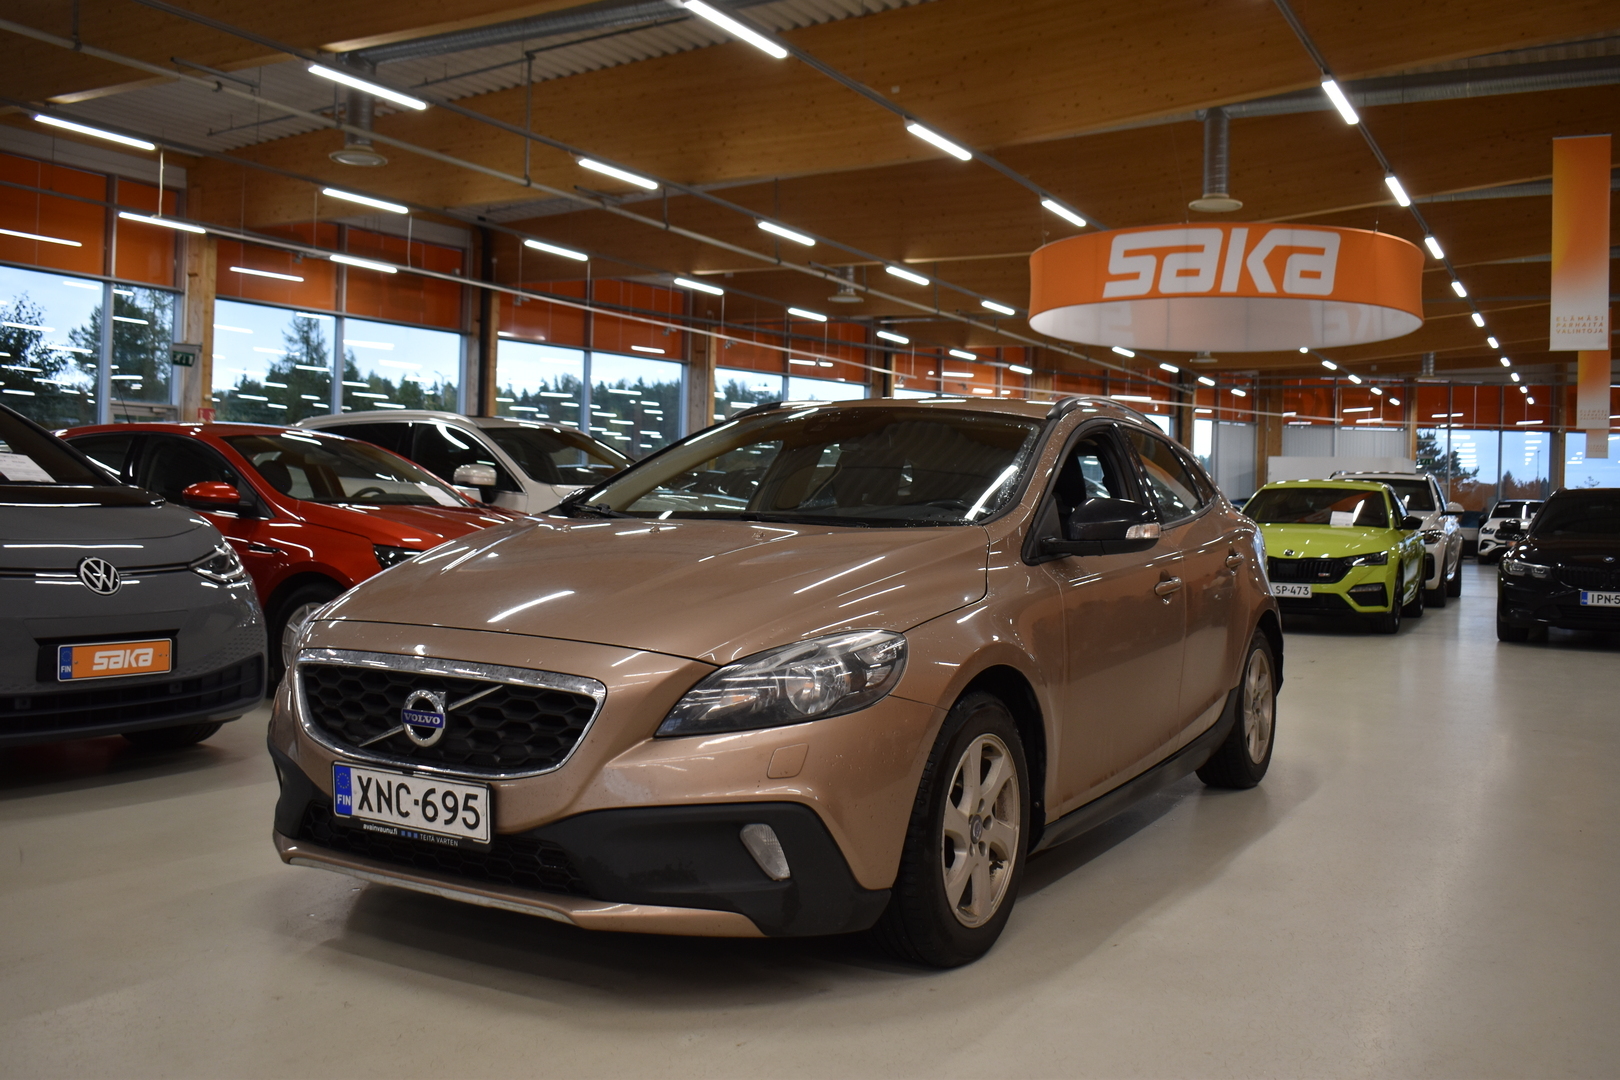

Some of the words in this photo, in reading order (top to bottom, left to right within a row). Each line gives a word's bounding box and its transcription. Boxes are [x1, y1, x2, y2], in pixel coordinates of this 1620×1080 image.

[1273, 585, 1309, 596] SP-473
[60, 665, 72, 673] FIN
[403, 712, 441, 725] VOLVO
[337, 794, 351, 806] FIN
[356, 775, 480, 830] XNC-695
[362, 823, 398, 835] avainvaunu.fi
[419, 833, 435, 843] TEITÄ
[436, 835, 459, 847] VARTEN
